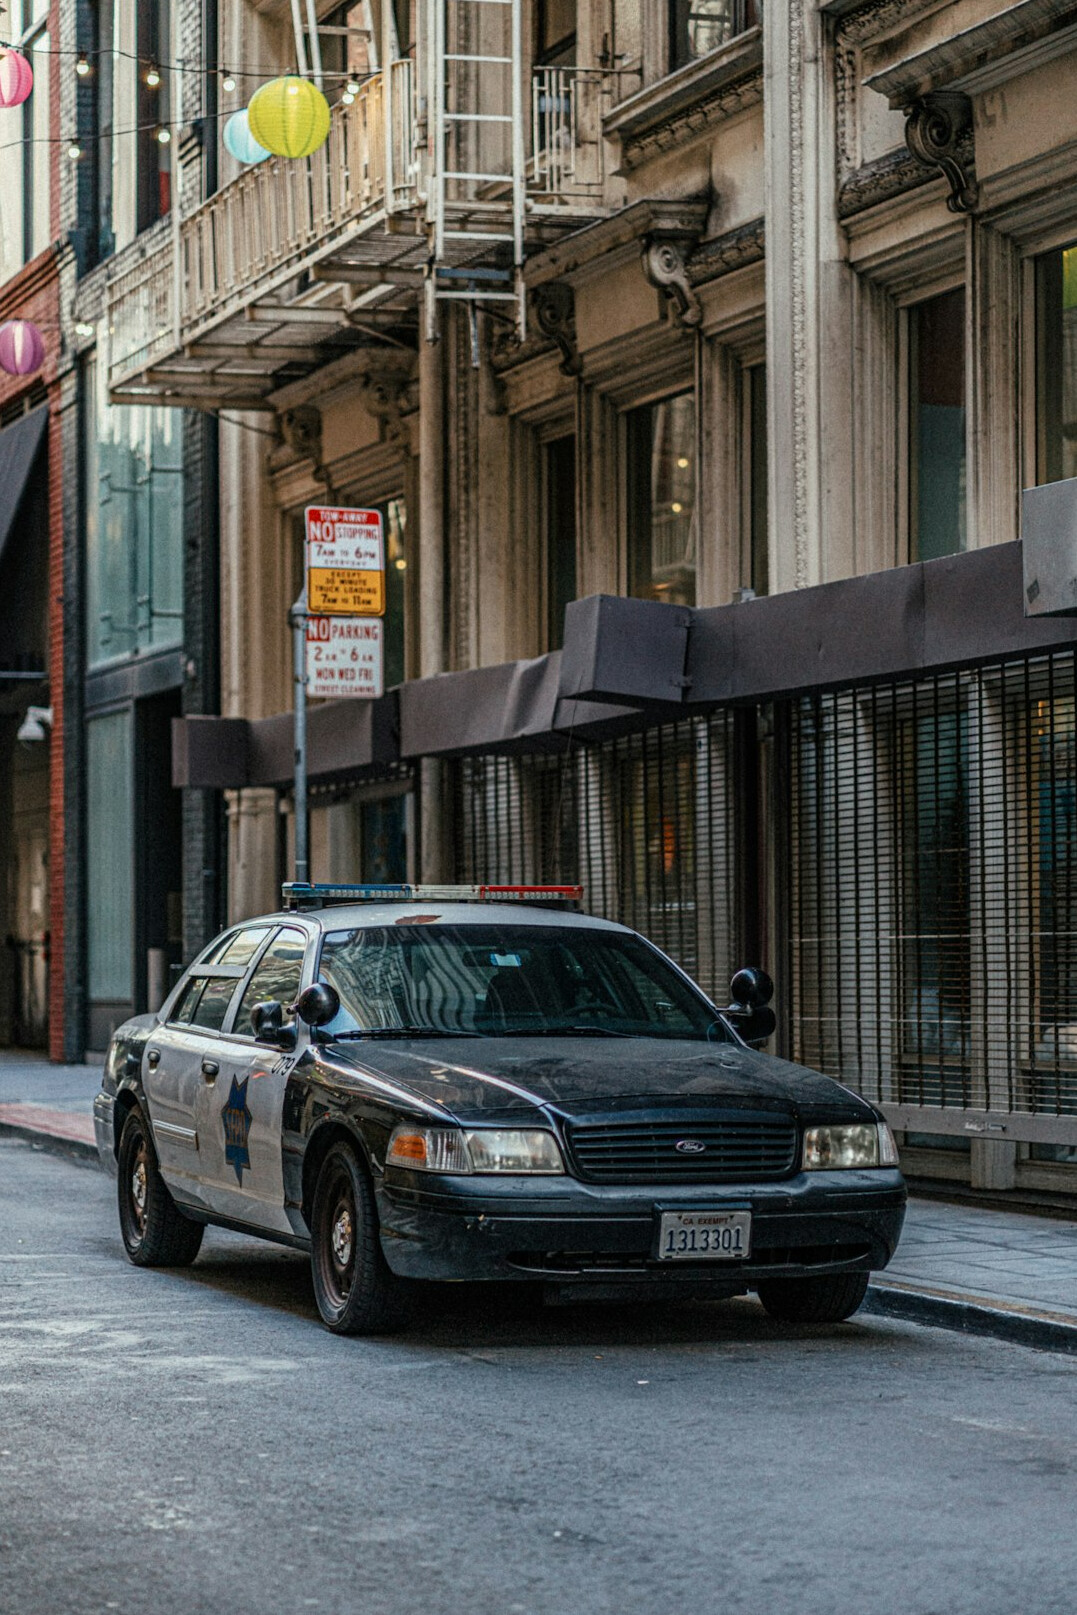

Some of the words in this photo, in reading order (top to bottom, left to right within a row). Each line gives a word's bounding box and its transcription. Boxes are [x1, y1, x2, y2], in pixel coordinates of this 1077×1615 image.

[309, 521, 334, 542] NO
[336, 526, 377, 540] STOPPING
[315, 585, 339, 593] TRUCK
[343, 586, 377, 595] LOADING
[308, 618, 329, 640] NO
[332, 624, 378, 640] PARKING
[316, 668, 335, 680] MON
[338, 668, 356, 680] WED
[359, 668, 373, 680] FRI
[271, 1055, 296, 1076] 079
[697, 1217, 729, 1225] EXEMPT
[665, 1228, 743, 1252] 1313301
